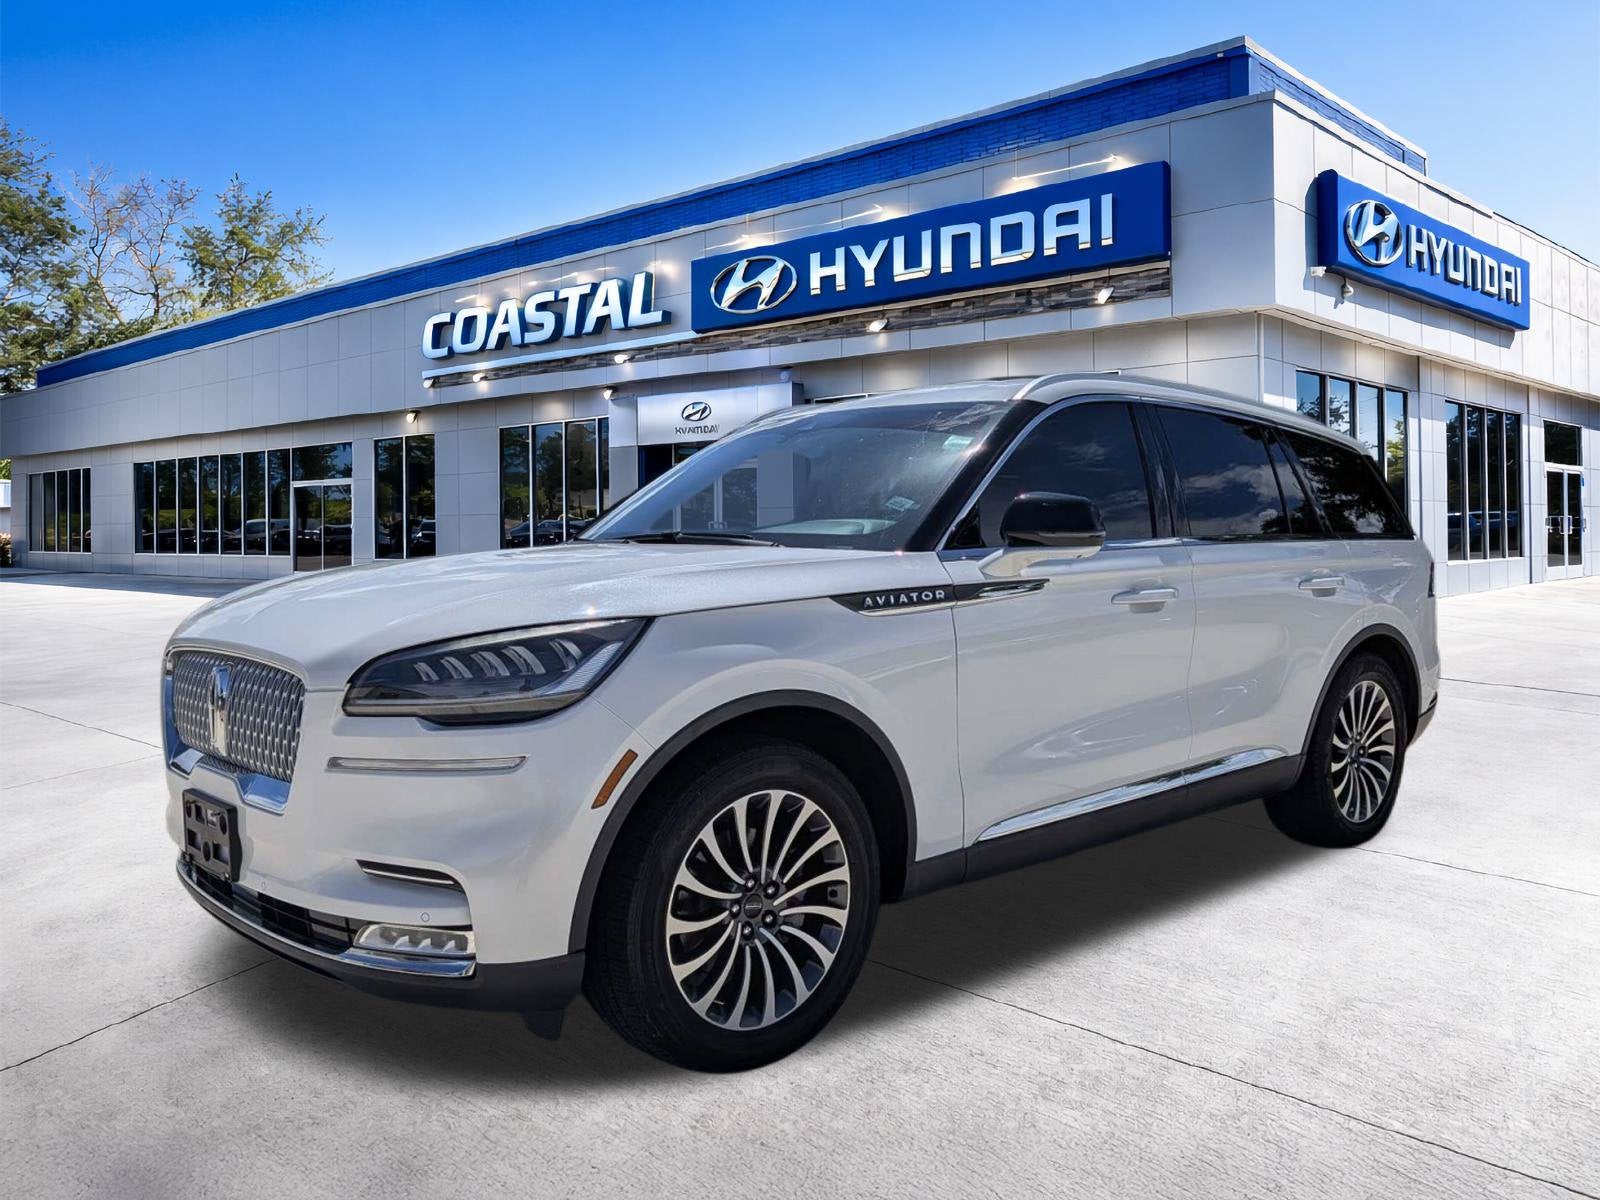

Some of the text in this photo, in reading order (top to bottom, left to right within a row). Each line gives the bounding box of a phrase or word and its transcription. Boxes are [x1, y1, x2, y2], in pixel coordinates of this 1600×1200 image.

[810, 192, 1113, 295] HYUNDAI
[1407, 224, 1521, 306] HYUNDAI
[422, 270, 668, 359] COASTAL
[863, 589, 946, 608] AVIATOR
